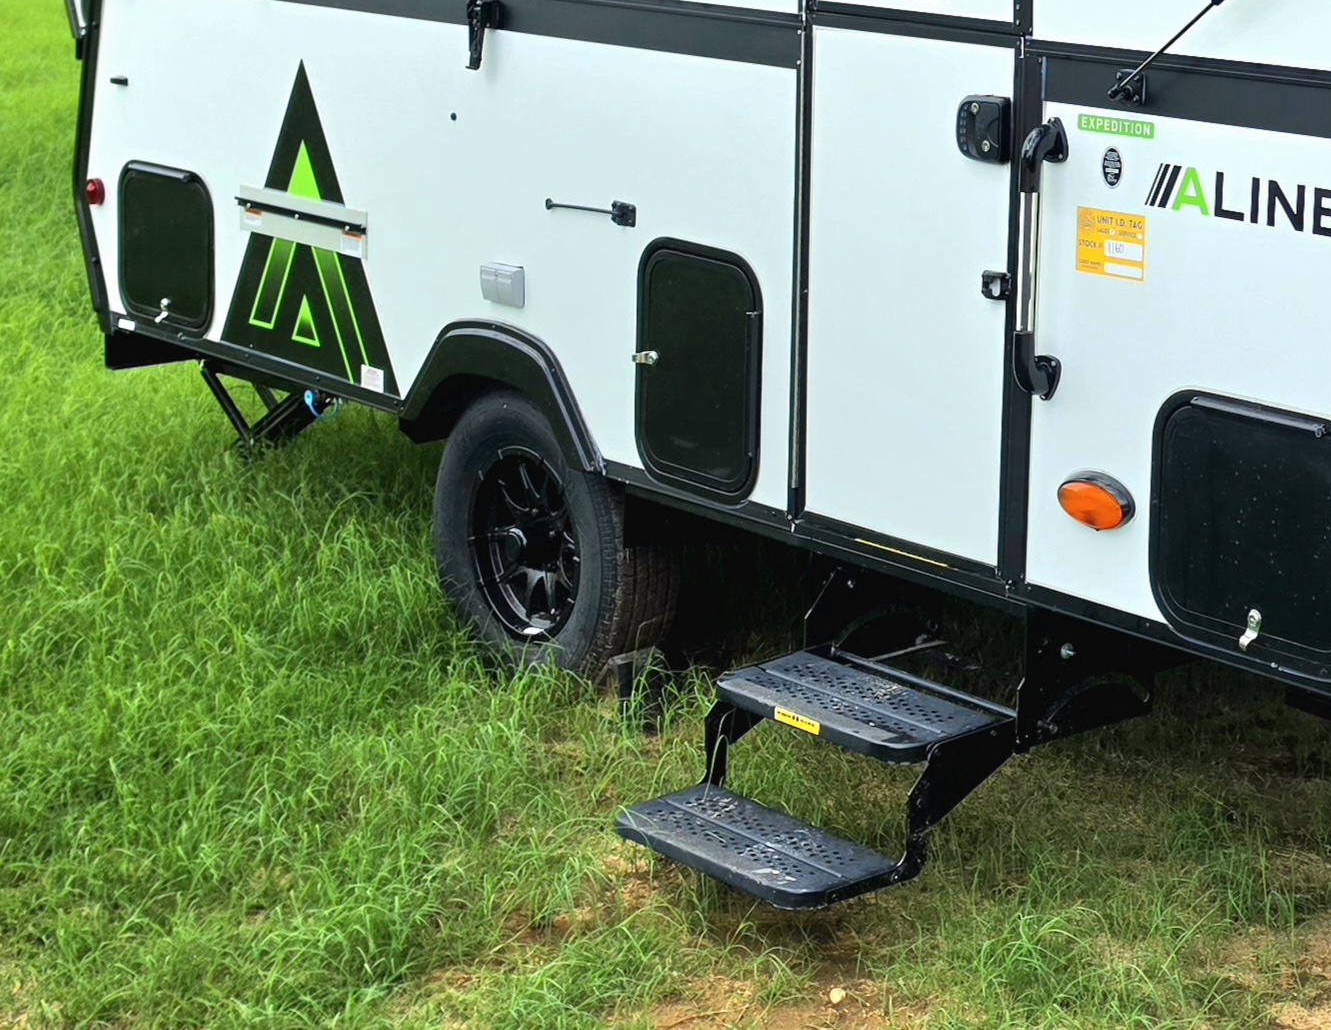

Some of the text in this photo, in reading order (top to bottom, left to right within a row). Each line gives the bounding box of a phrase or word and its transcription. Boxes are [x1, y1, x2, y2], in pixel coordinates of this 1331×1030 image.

[1081, 116, 1151, 136] EXPEDITION
[1096, 215, 1113, 225] UNIT
[1129, 220, 1142, 230] TAG
[1079, 239, 1097, 248] STOCK
